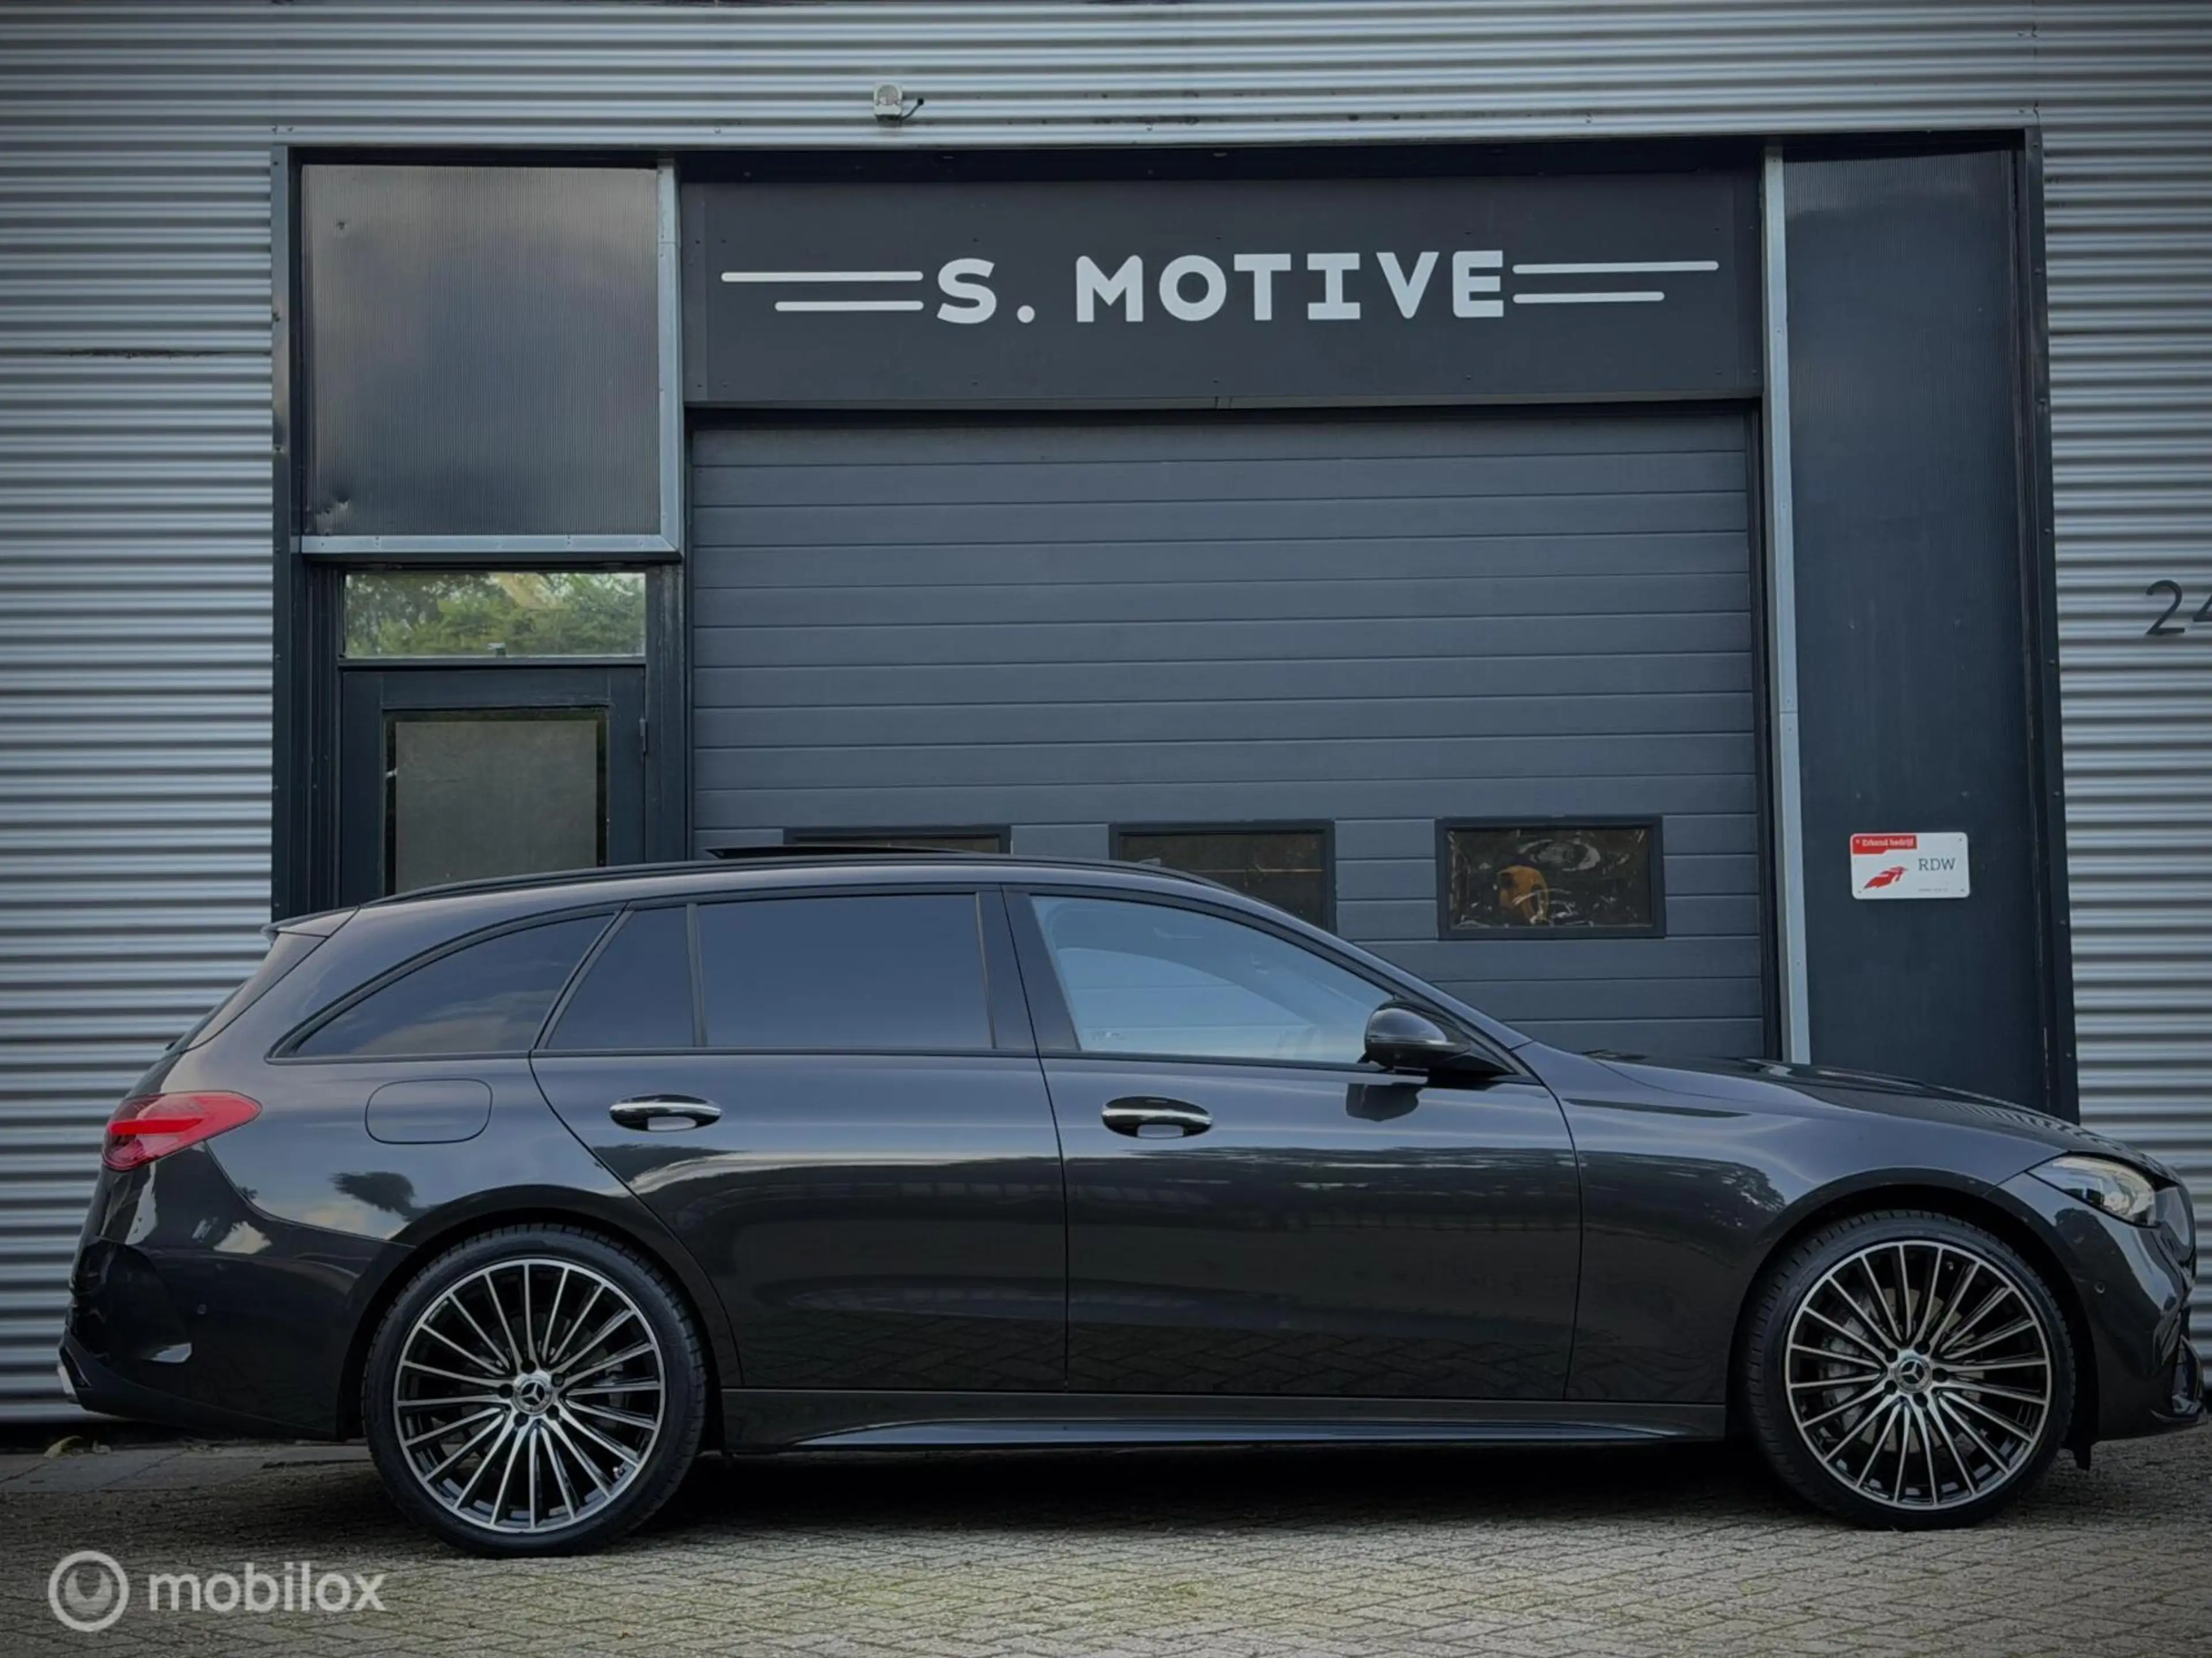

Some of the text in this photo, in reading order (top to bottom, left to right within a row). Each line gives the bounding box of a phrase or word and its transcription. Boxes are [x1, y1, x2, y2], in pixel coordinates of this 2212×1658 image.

[937, 250, 1503, 324] S. MOTIVE
[1918, 858, 1956, 871] RDW
